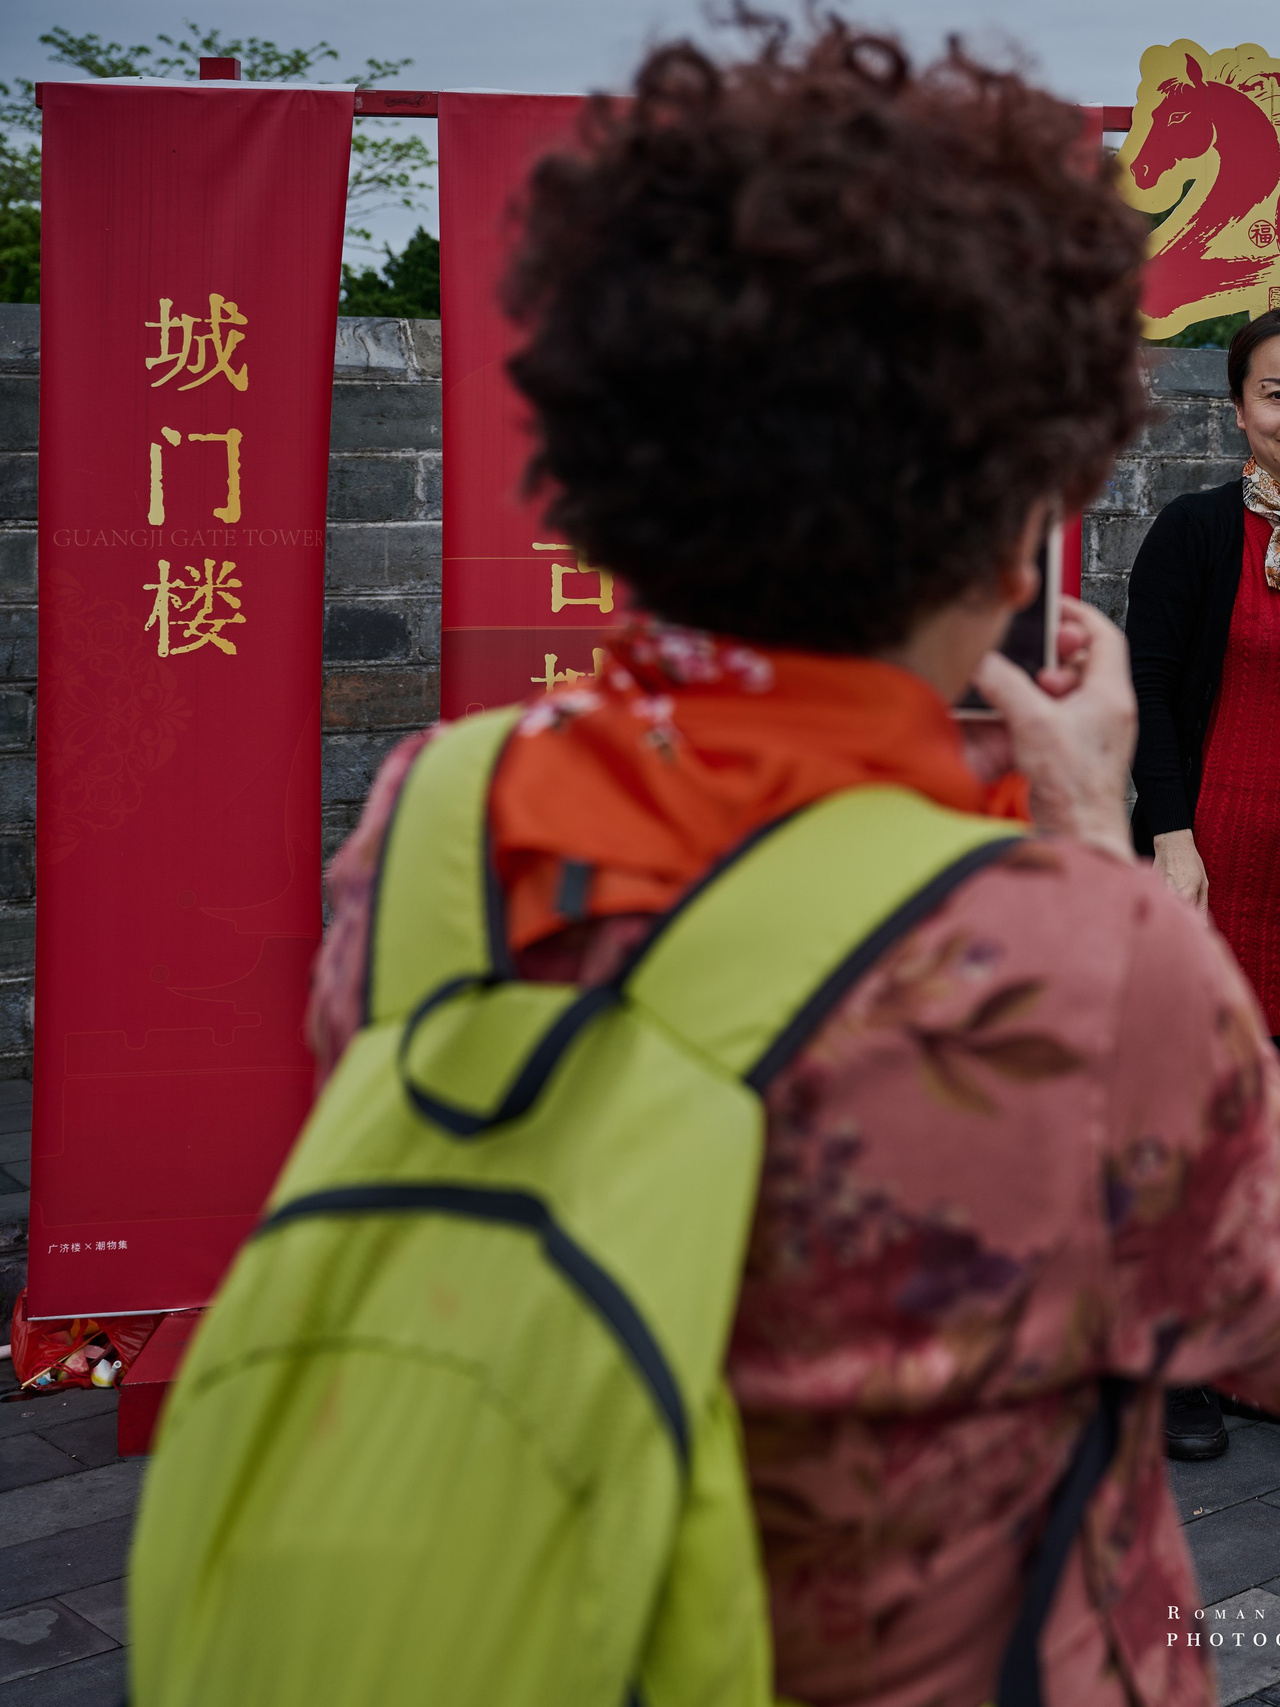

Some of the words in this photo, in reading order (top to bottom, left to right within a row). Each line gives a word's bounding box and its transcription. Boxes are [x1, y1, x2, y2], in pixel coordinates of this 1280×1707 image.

[1250, 224, 1272, 244] 福
[143, 293, 249, 656] 城门楼
[53, 529, 163, 549] GUANGJI
[170, 529, 236, 546] GATE
[242, 529, 323, 546] TOWER
[48, 1242, 81, 1254] 广济楼
[95, 1240, 128, 1251] 潮物集
